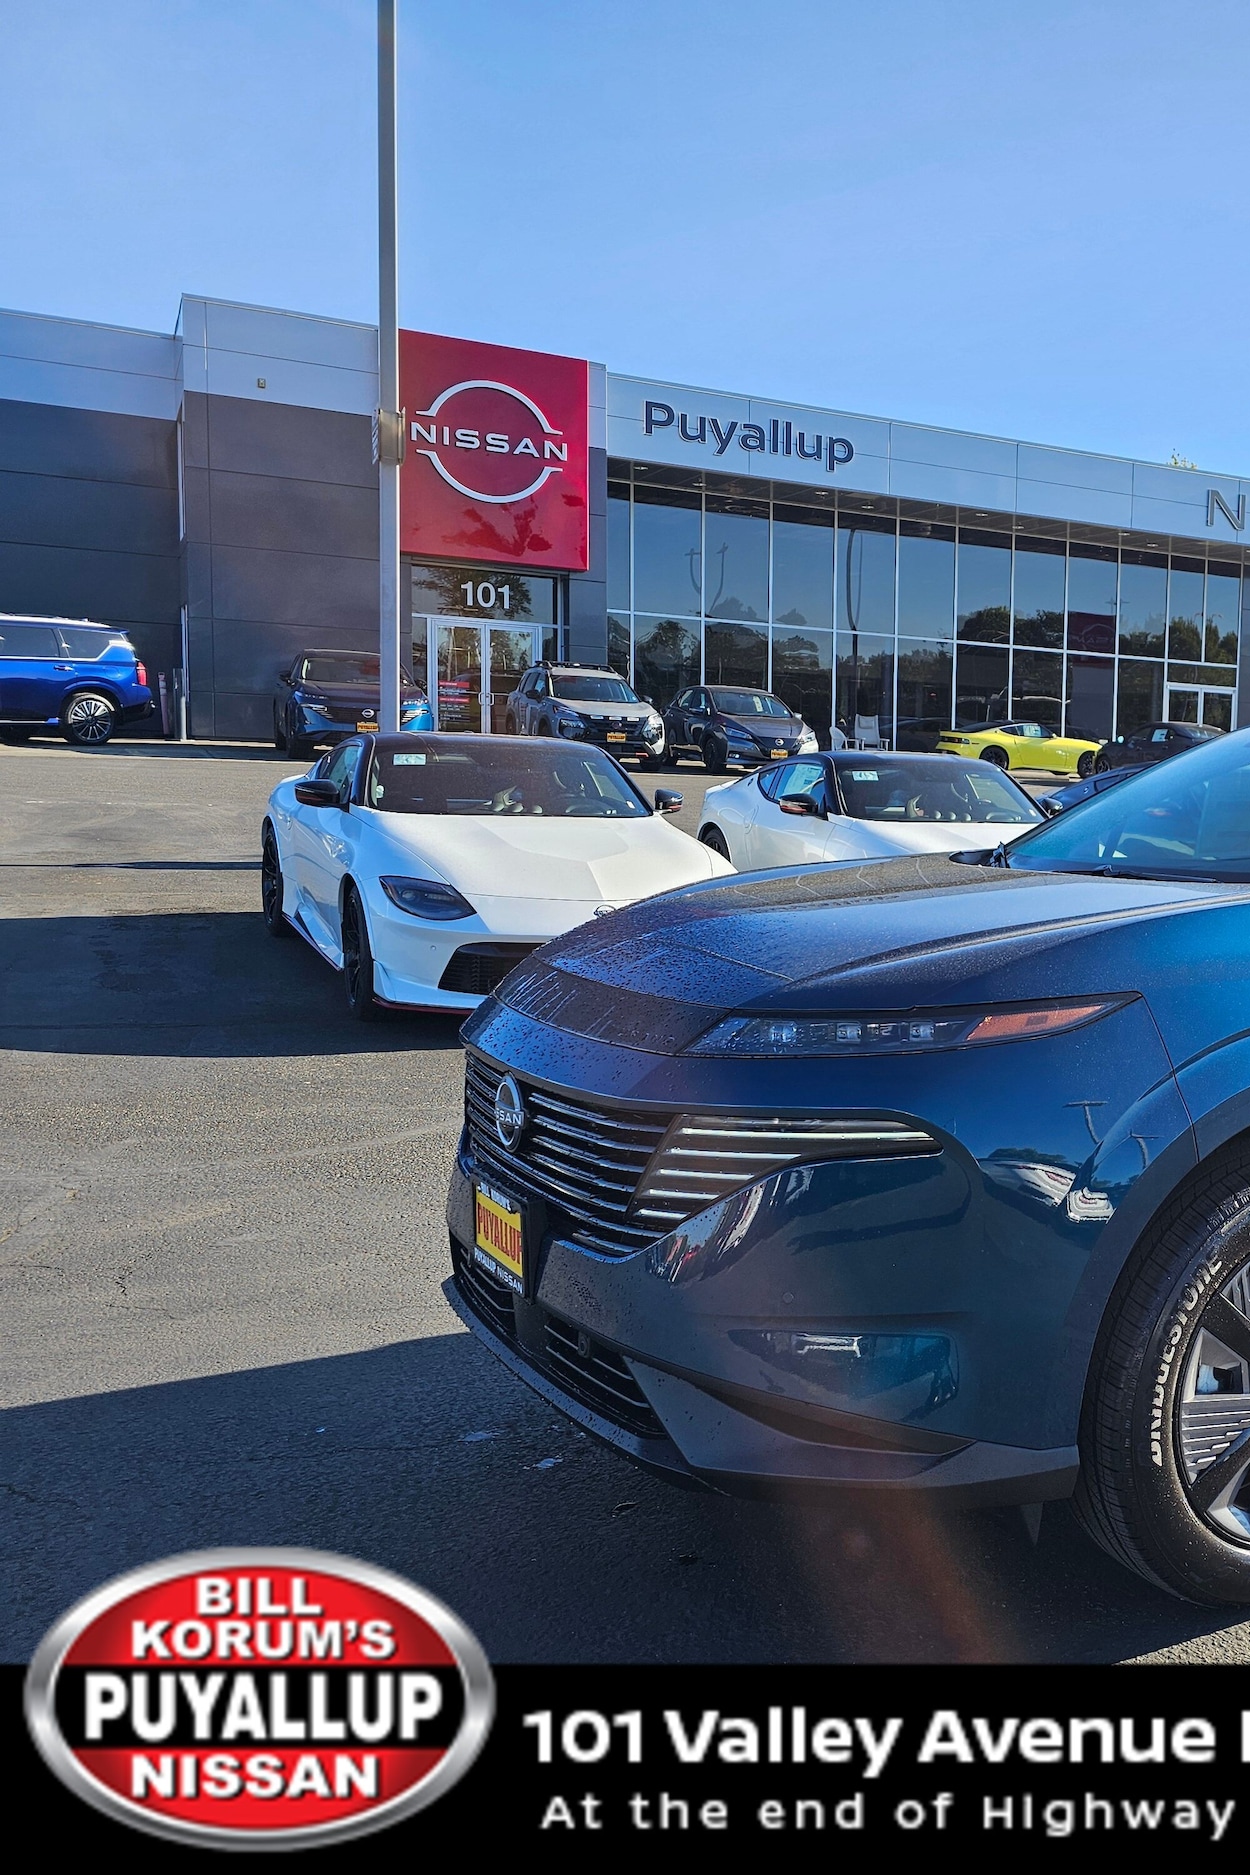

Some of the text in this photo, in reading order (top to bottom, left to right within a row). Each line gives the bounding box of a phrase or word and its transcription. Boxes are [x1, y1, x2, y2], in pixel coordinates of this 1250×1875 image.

[411, 421, 568, 462] NISSAN
[643, 400, 855, 473] Puyallup
[460, 581, 511, 610] 101
[477, 1202, 523, 1265] PUYALLUP
